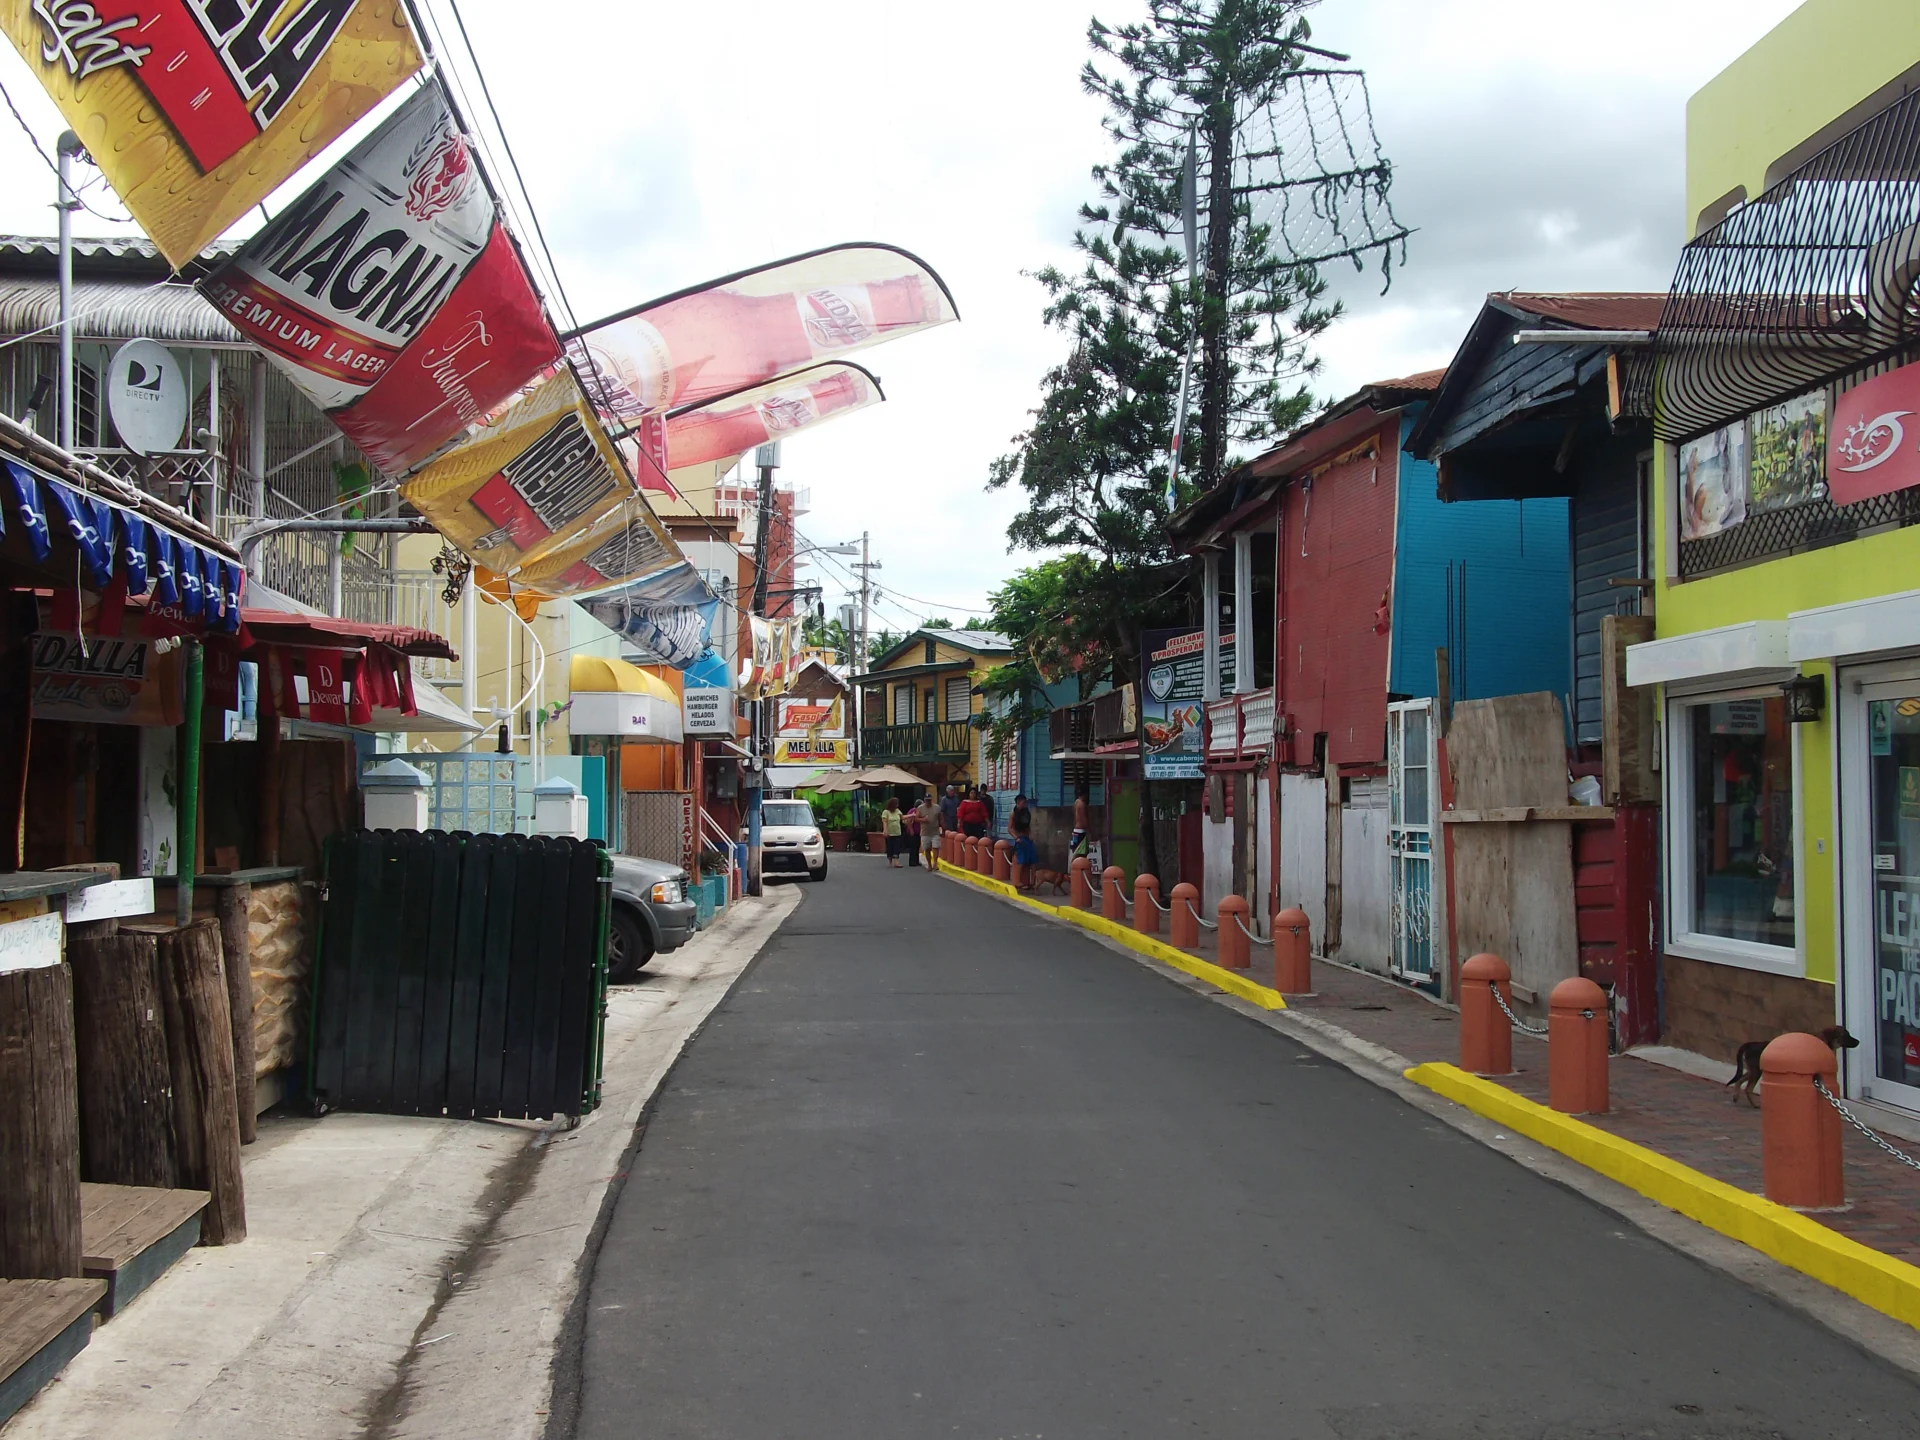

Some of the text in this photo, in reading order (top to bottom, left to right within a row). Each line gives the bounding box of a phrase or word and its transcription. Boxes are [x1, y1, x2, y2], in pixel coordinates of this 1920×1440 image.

[246, 179, 458, 339] MAGNA
[210, 281, 387, 374] PREMIUM LAGER
[126, 389, 161, 402] DIRECTV
[500, 409, 620, 535] MEDALLA
[1157, 643, 1193, 659] PROSPERO
[686, 694, 719, 702] SANDWICHES
[631, 715, 647, 725] BAR
[691, 711, 715, 719] HELADOS
[689, 719, 716, 727] CERVEZAS
[1881, 968, 1920, 1029] PAC
